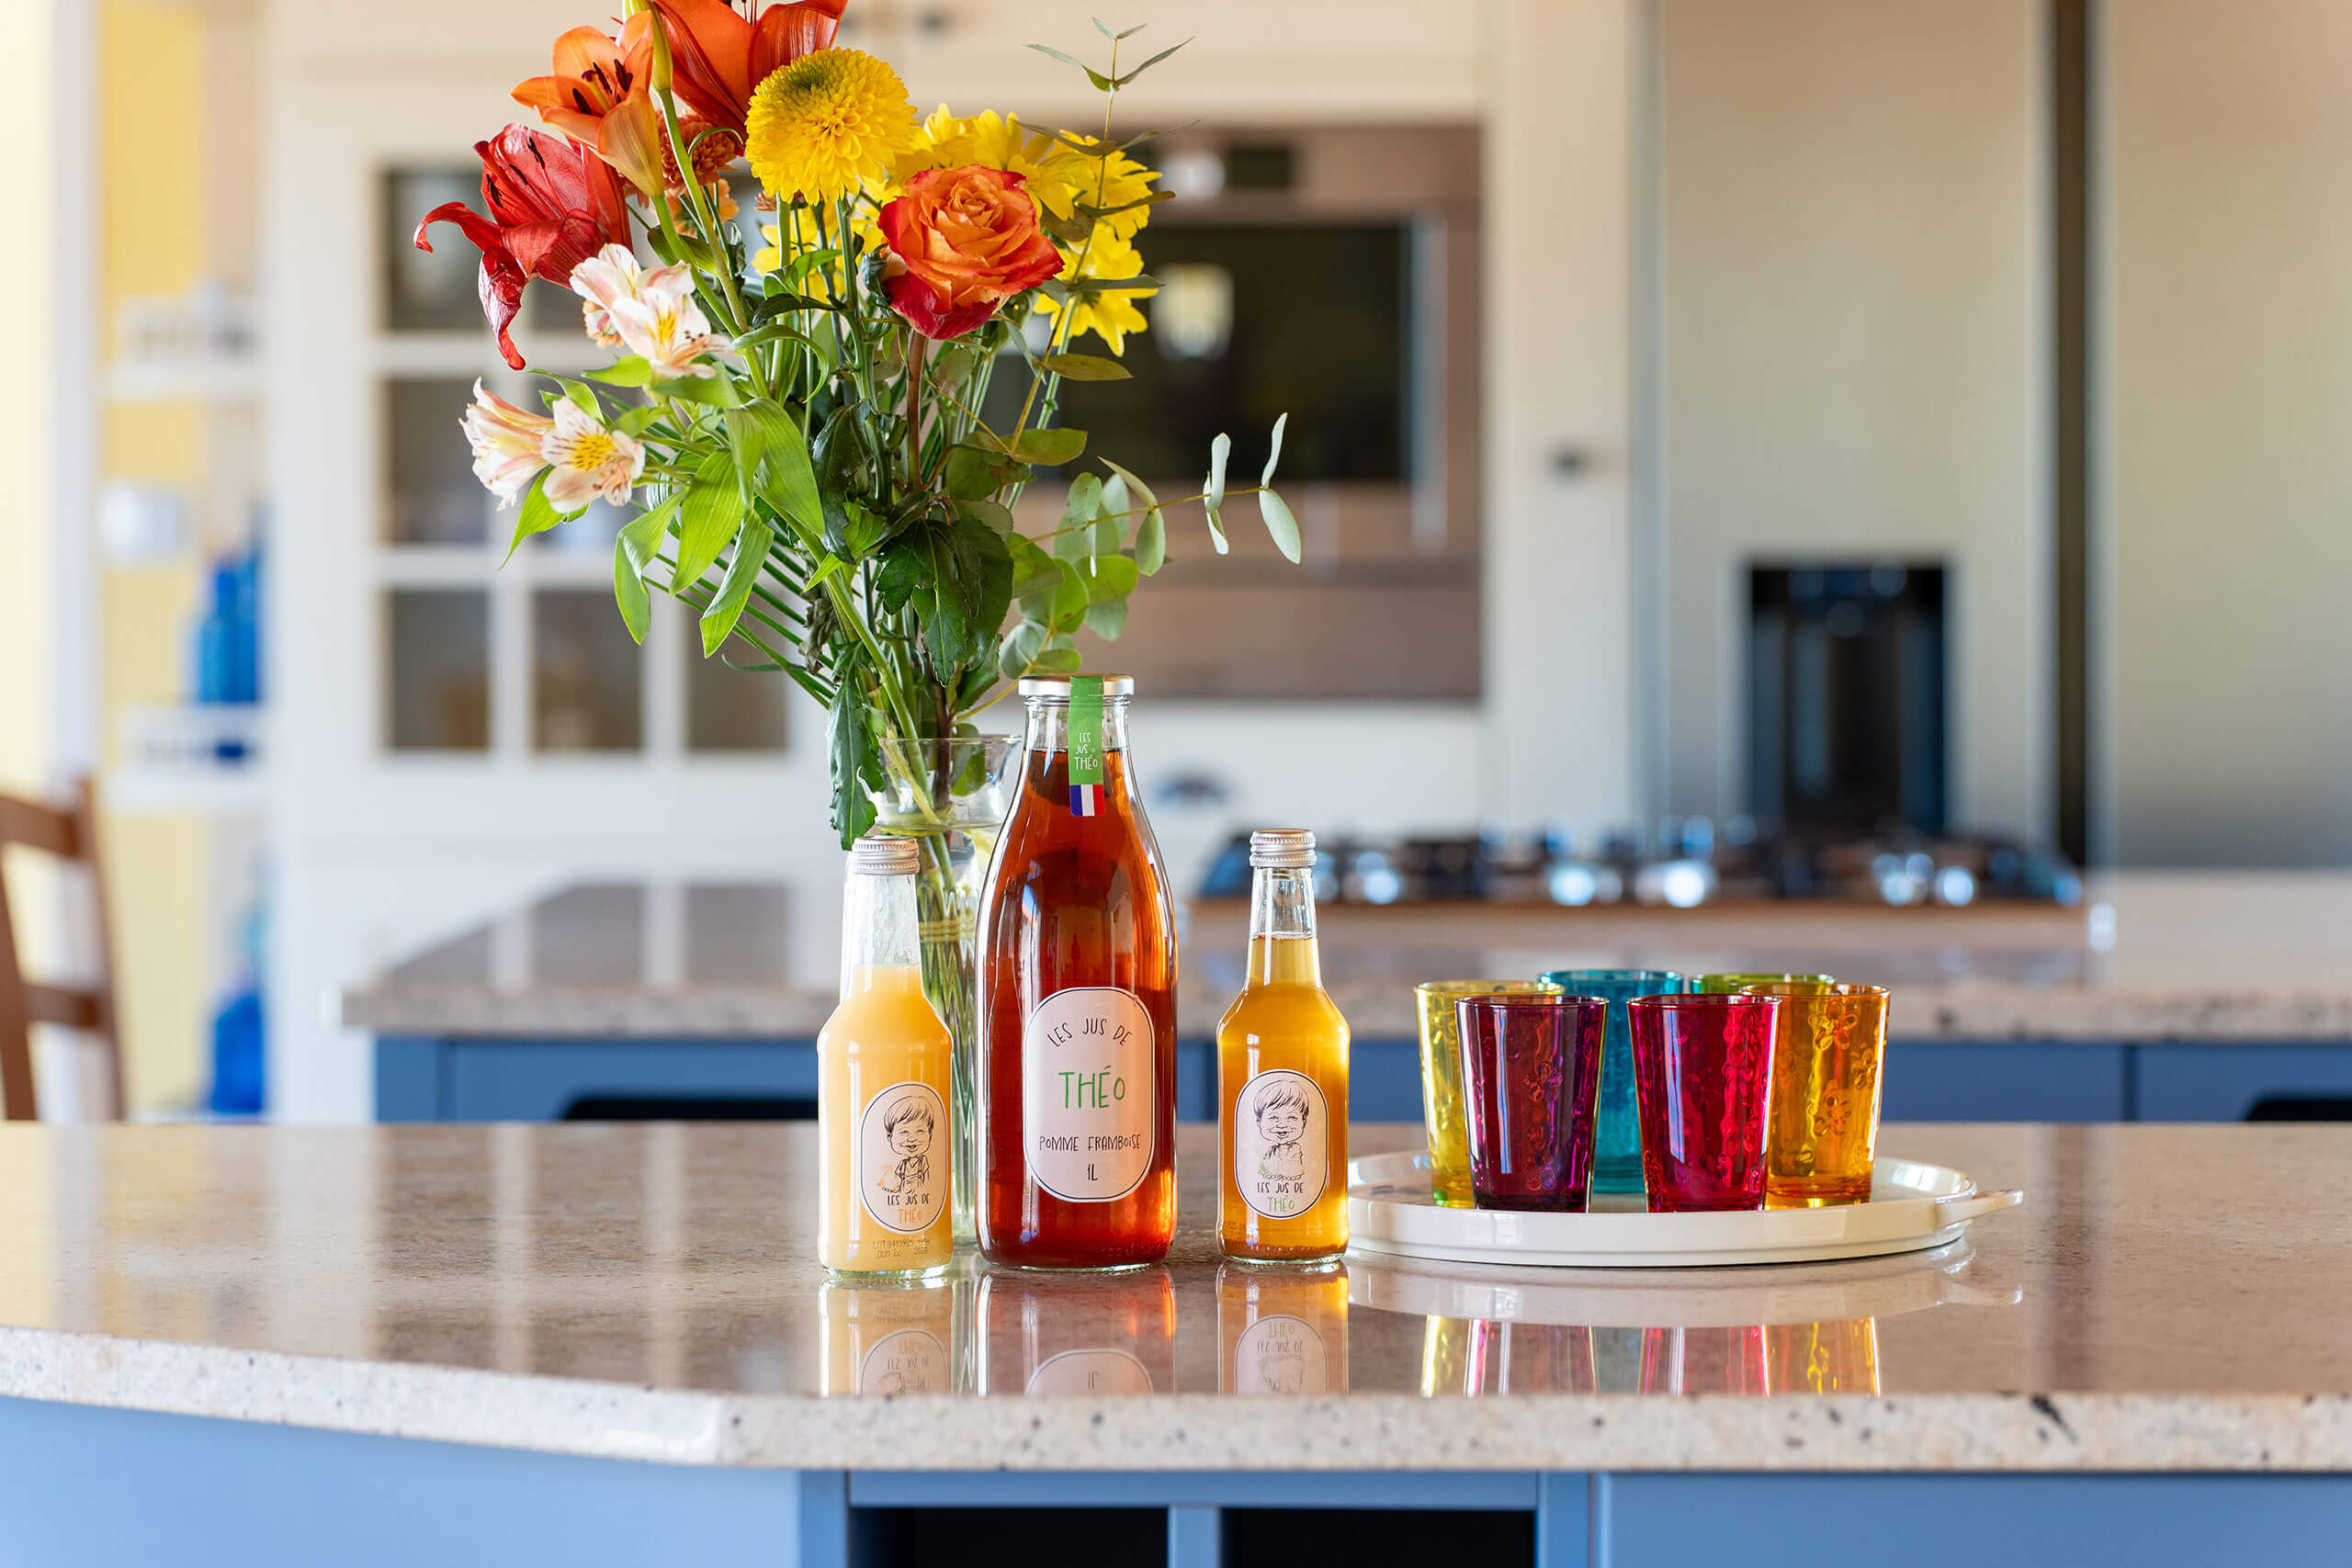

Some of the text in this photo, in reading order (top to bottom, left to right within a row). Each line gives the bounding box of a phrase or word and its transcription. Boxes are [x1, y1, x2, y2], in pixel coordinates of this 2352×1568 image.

[1080, 732, 1091, 743] LES
[1075, 744, 1088, 755] JUS
[1047, 1018, 1132, 1047] LES JUS DE
[1039, 1135, 1080, 1152] POMME
[1088, 1164, 1098, 1181] 1L
[1257, 1182, 1303, 1193] LES JUS DE
[888, 1193, 930, 1205] LES JUS DE
